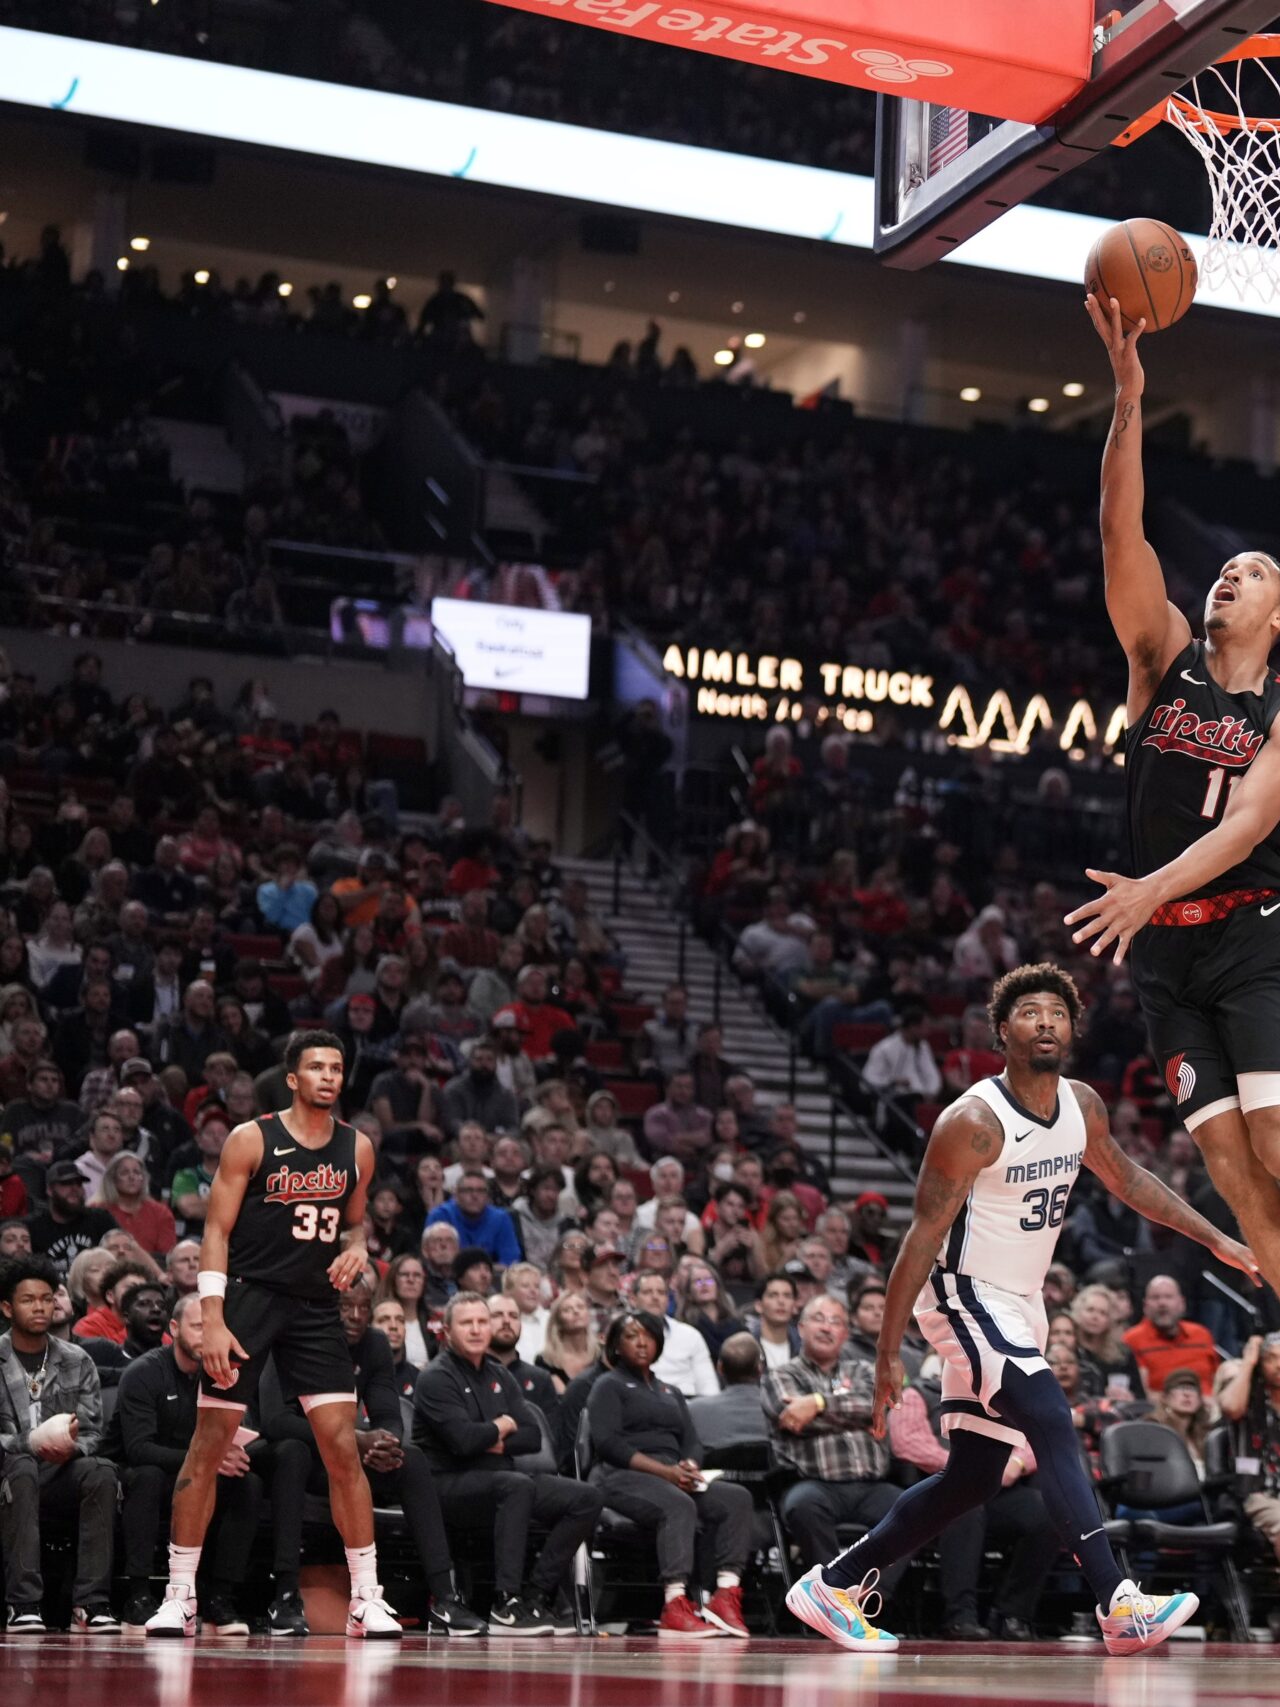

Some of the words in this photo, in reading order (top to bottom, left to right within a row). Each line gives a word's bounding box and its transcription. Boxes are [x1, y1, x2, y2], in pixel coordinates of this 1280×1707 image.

[697, 686, 768, 721] North
[820, 662, 934, 728] TRUCK
[1142, 698, 1265, 768] ripcity
[263, 1162, 348, 1206] ripcity
[292, 1203, 341, 1243] 33
[1019, 1183, 1070, 1232] 36
